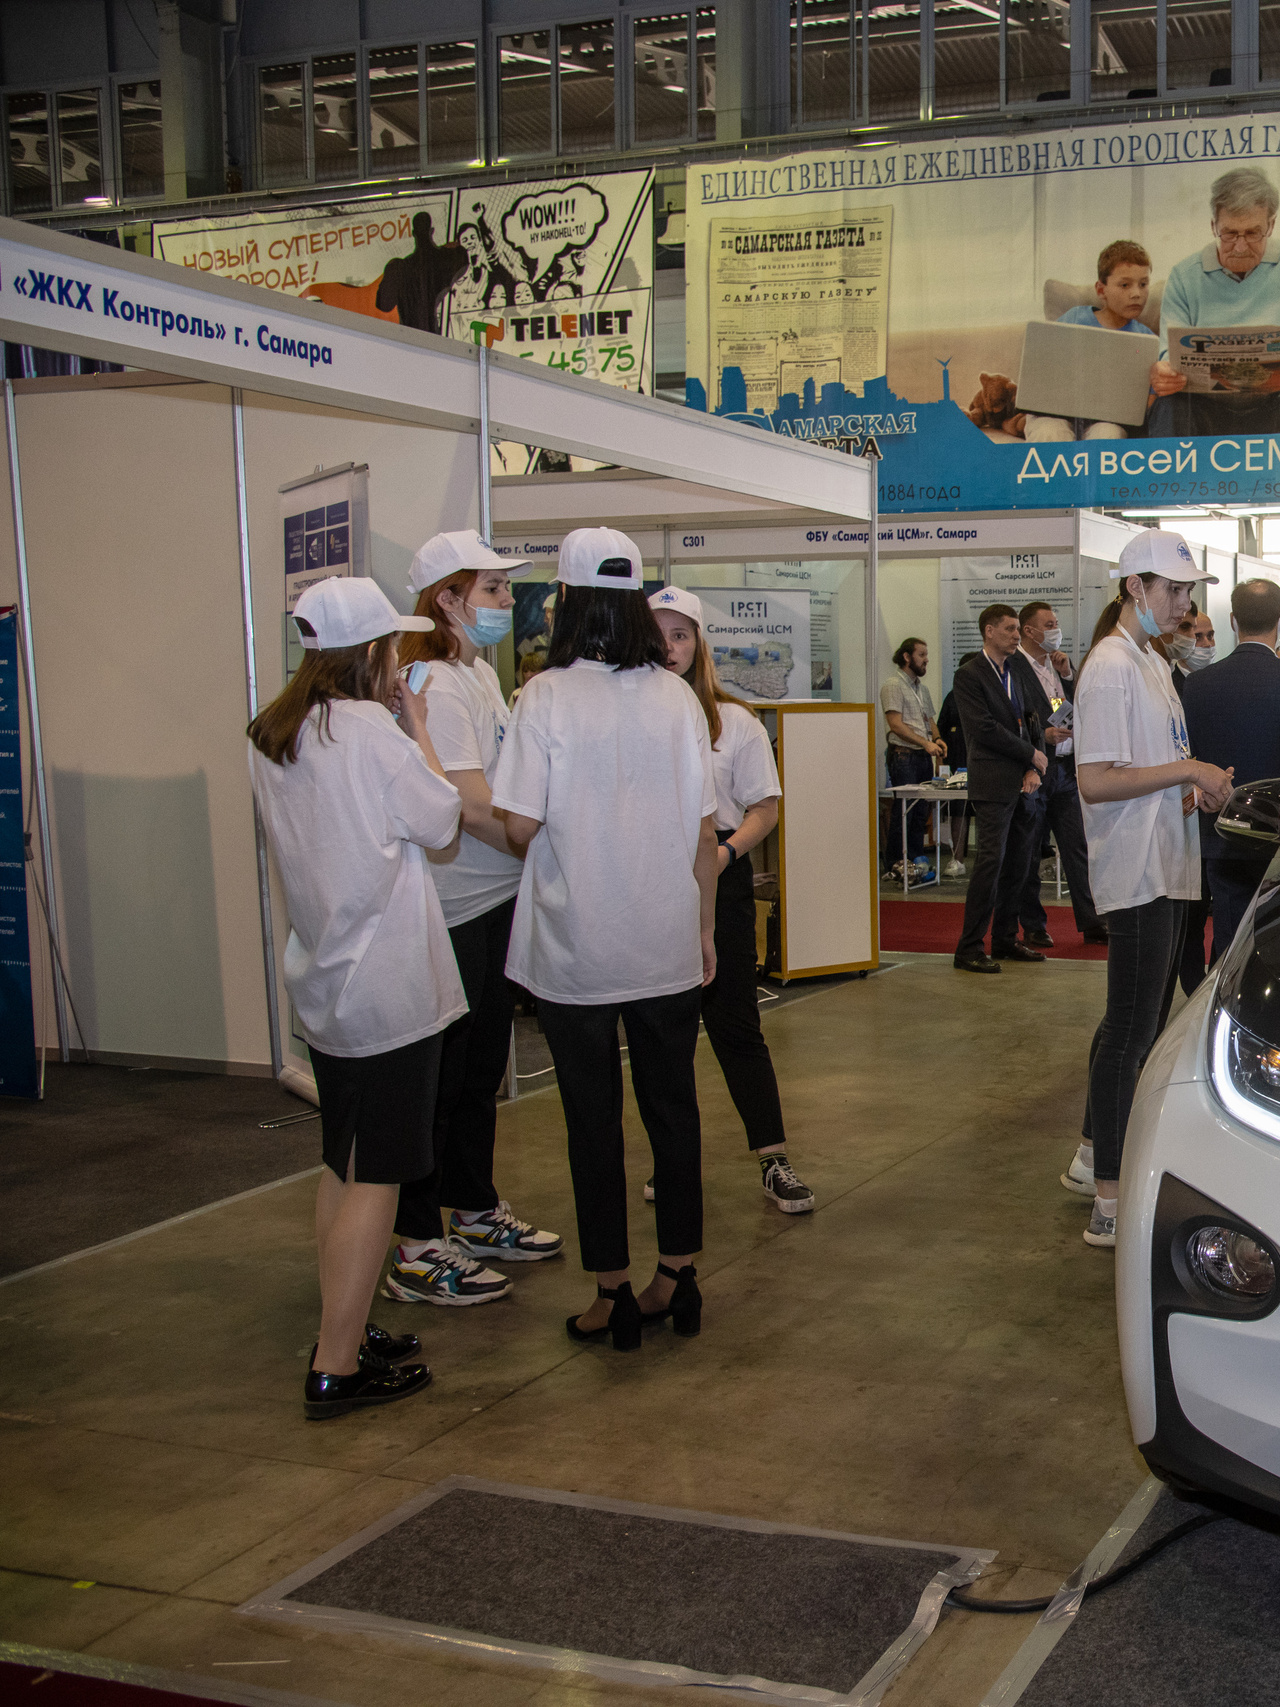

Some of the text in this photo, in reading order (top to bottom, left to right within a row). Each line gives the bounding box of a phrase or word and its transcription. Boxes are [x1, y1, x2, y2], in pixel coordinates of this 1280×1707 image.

[701, 156, 897, 202] ЕДИНСТВЕННАЯ
[902, 137, 1085, 182] ЕЖЕДНЕВНАЯ
[1093, 124, 1254, 168] ГОРОДСКАЯ
[519, 199, 576, 230] WOW!!!
[183, 213, 413, 272] НОВЫЙ СУПЕРГЕРОЙ
[530, 232, 540, 244] НУ
[735, 230, 812, 255] САМАРСКАЯ
[815, 226, 865, 250] ГАЗЕТА
[13, 269, 333, 368] «ЖКХ Контроль» г. Самара
[510, 310, 633, 342] TELENET
[598, 344, 635, 373] 75
[1017, 447, 1089, 484] Для
[1099, 441, 1198, 476] всей
[879, 484, 961, 501] 1884 года
[1110, 480, 1239, 498] тел.979-75-80
[806, 530, 829, 543] ФБУ
[936, 527, 978, 542] Самара
[524, 543, 559, 556] Самара
[995, 571, 1055, 581] Самарский ЦСМ
[969, 588, 1007, 596] ОСНОВНЫЕ
[1008, 587, 1028, 595] ВИДЫ
[707, 623, 792, 636] Самарский ЦСМ
